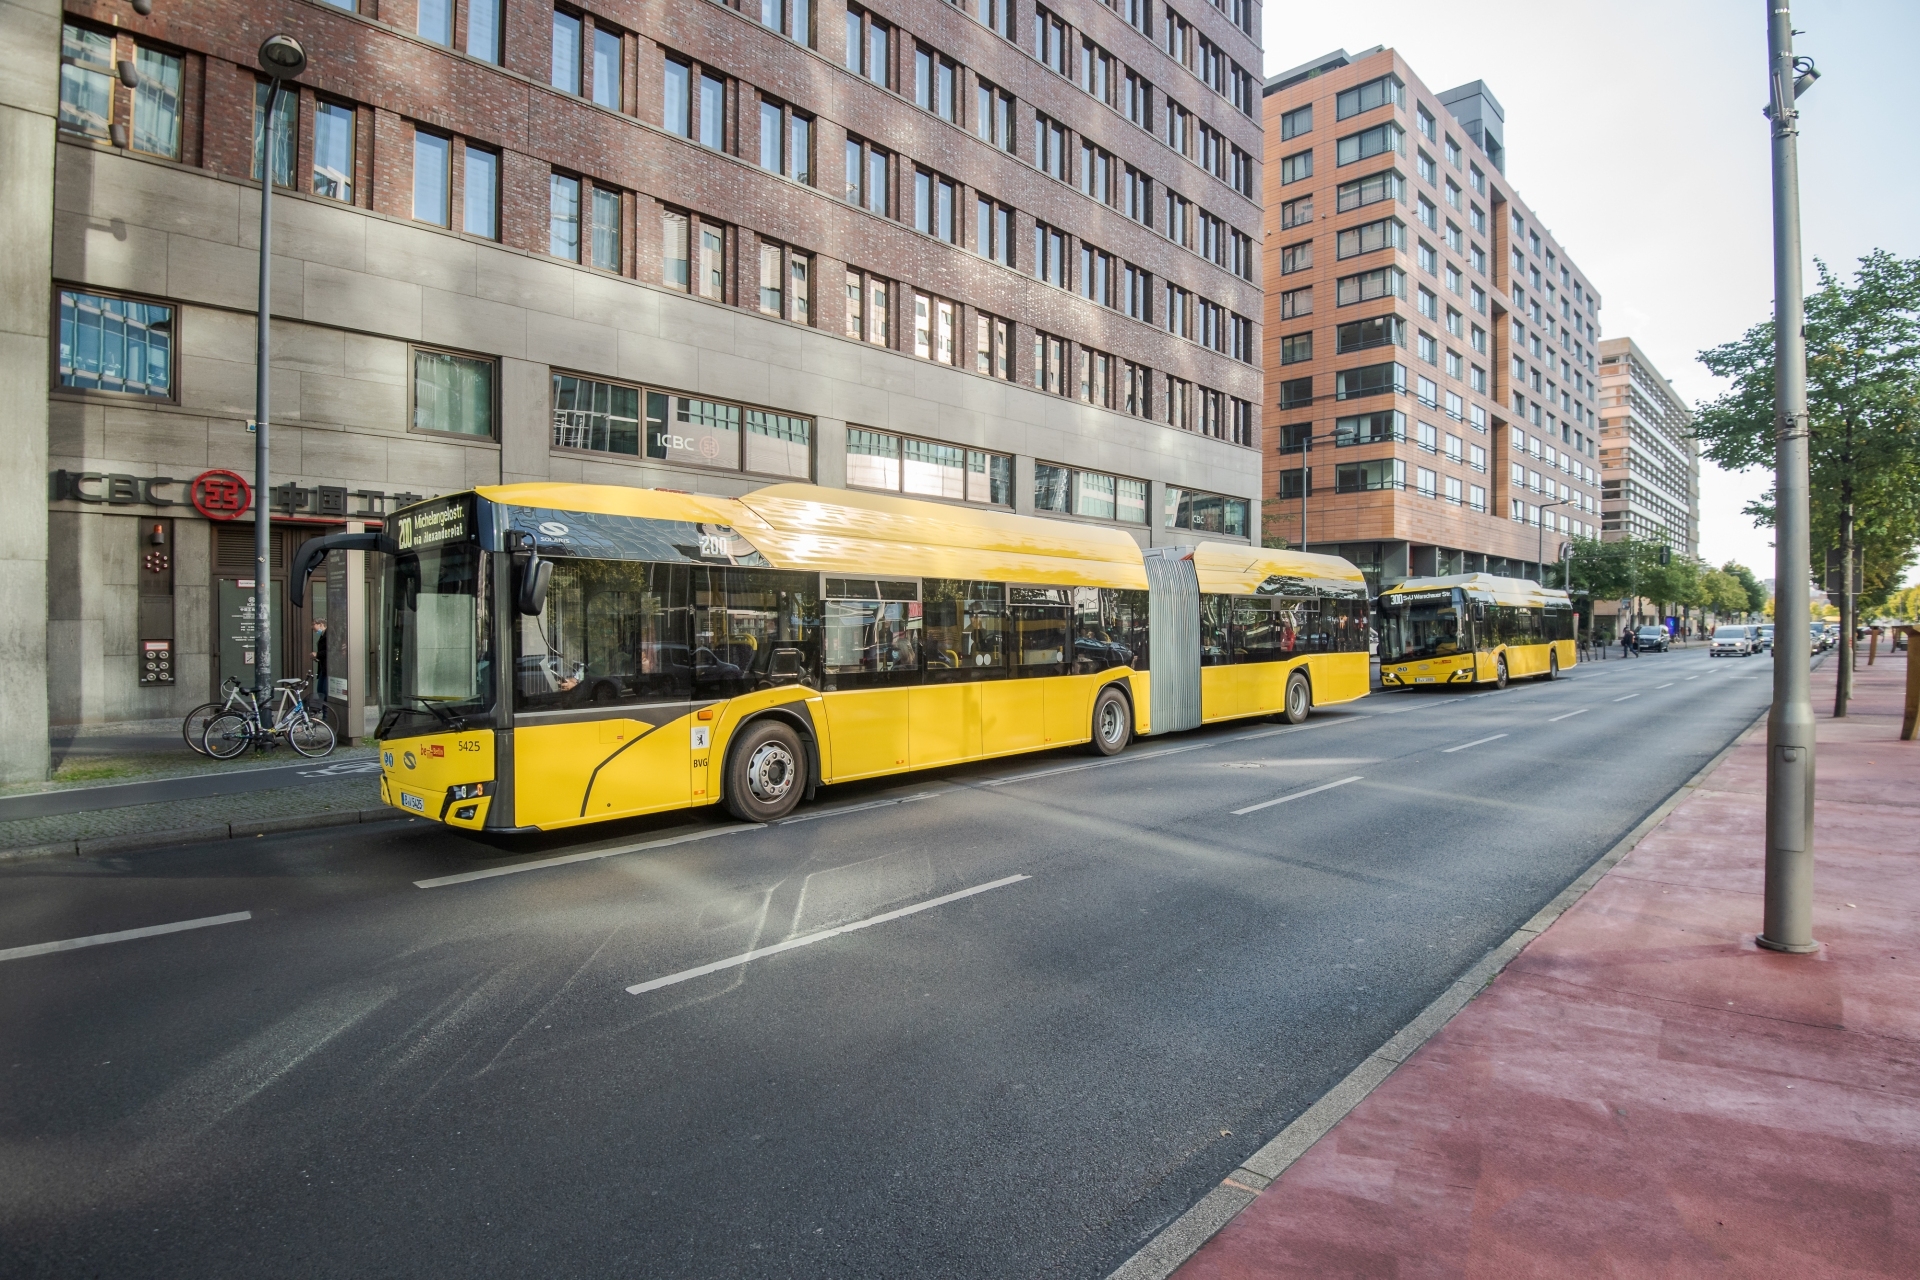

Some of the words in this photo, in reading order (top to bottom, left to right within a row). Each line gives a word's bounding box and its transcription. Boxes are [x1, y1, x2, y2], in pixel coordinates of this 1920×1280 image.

[657, 432, 695, 451] ICBC
[57, 469, 174, 506] ICBC
[277, 482, 440, 518] 中国工
[414, 503, 465, 530] Michelangelostr.
[398, 517, 412, 550] 200
[413, 534, 422, 545] via
[540, 536, 570, 544] SOLARIS
[701, 535, 727, 556] 200
[1390, 593, 1403, 605] 300
[1413, 592, 1441, 600] Warschauer
[420, 744, 427, 756] be
[458, 741, 481, 751] 5425
[693, 758, 708, 768] BVG
